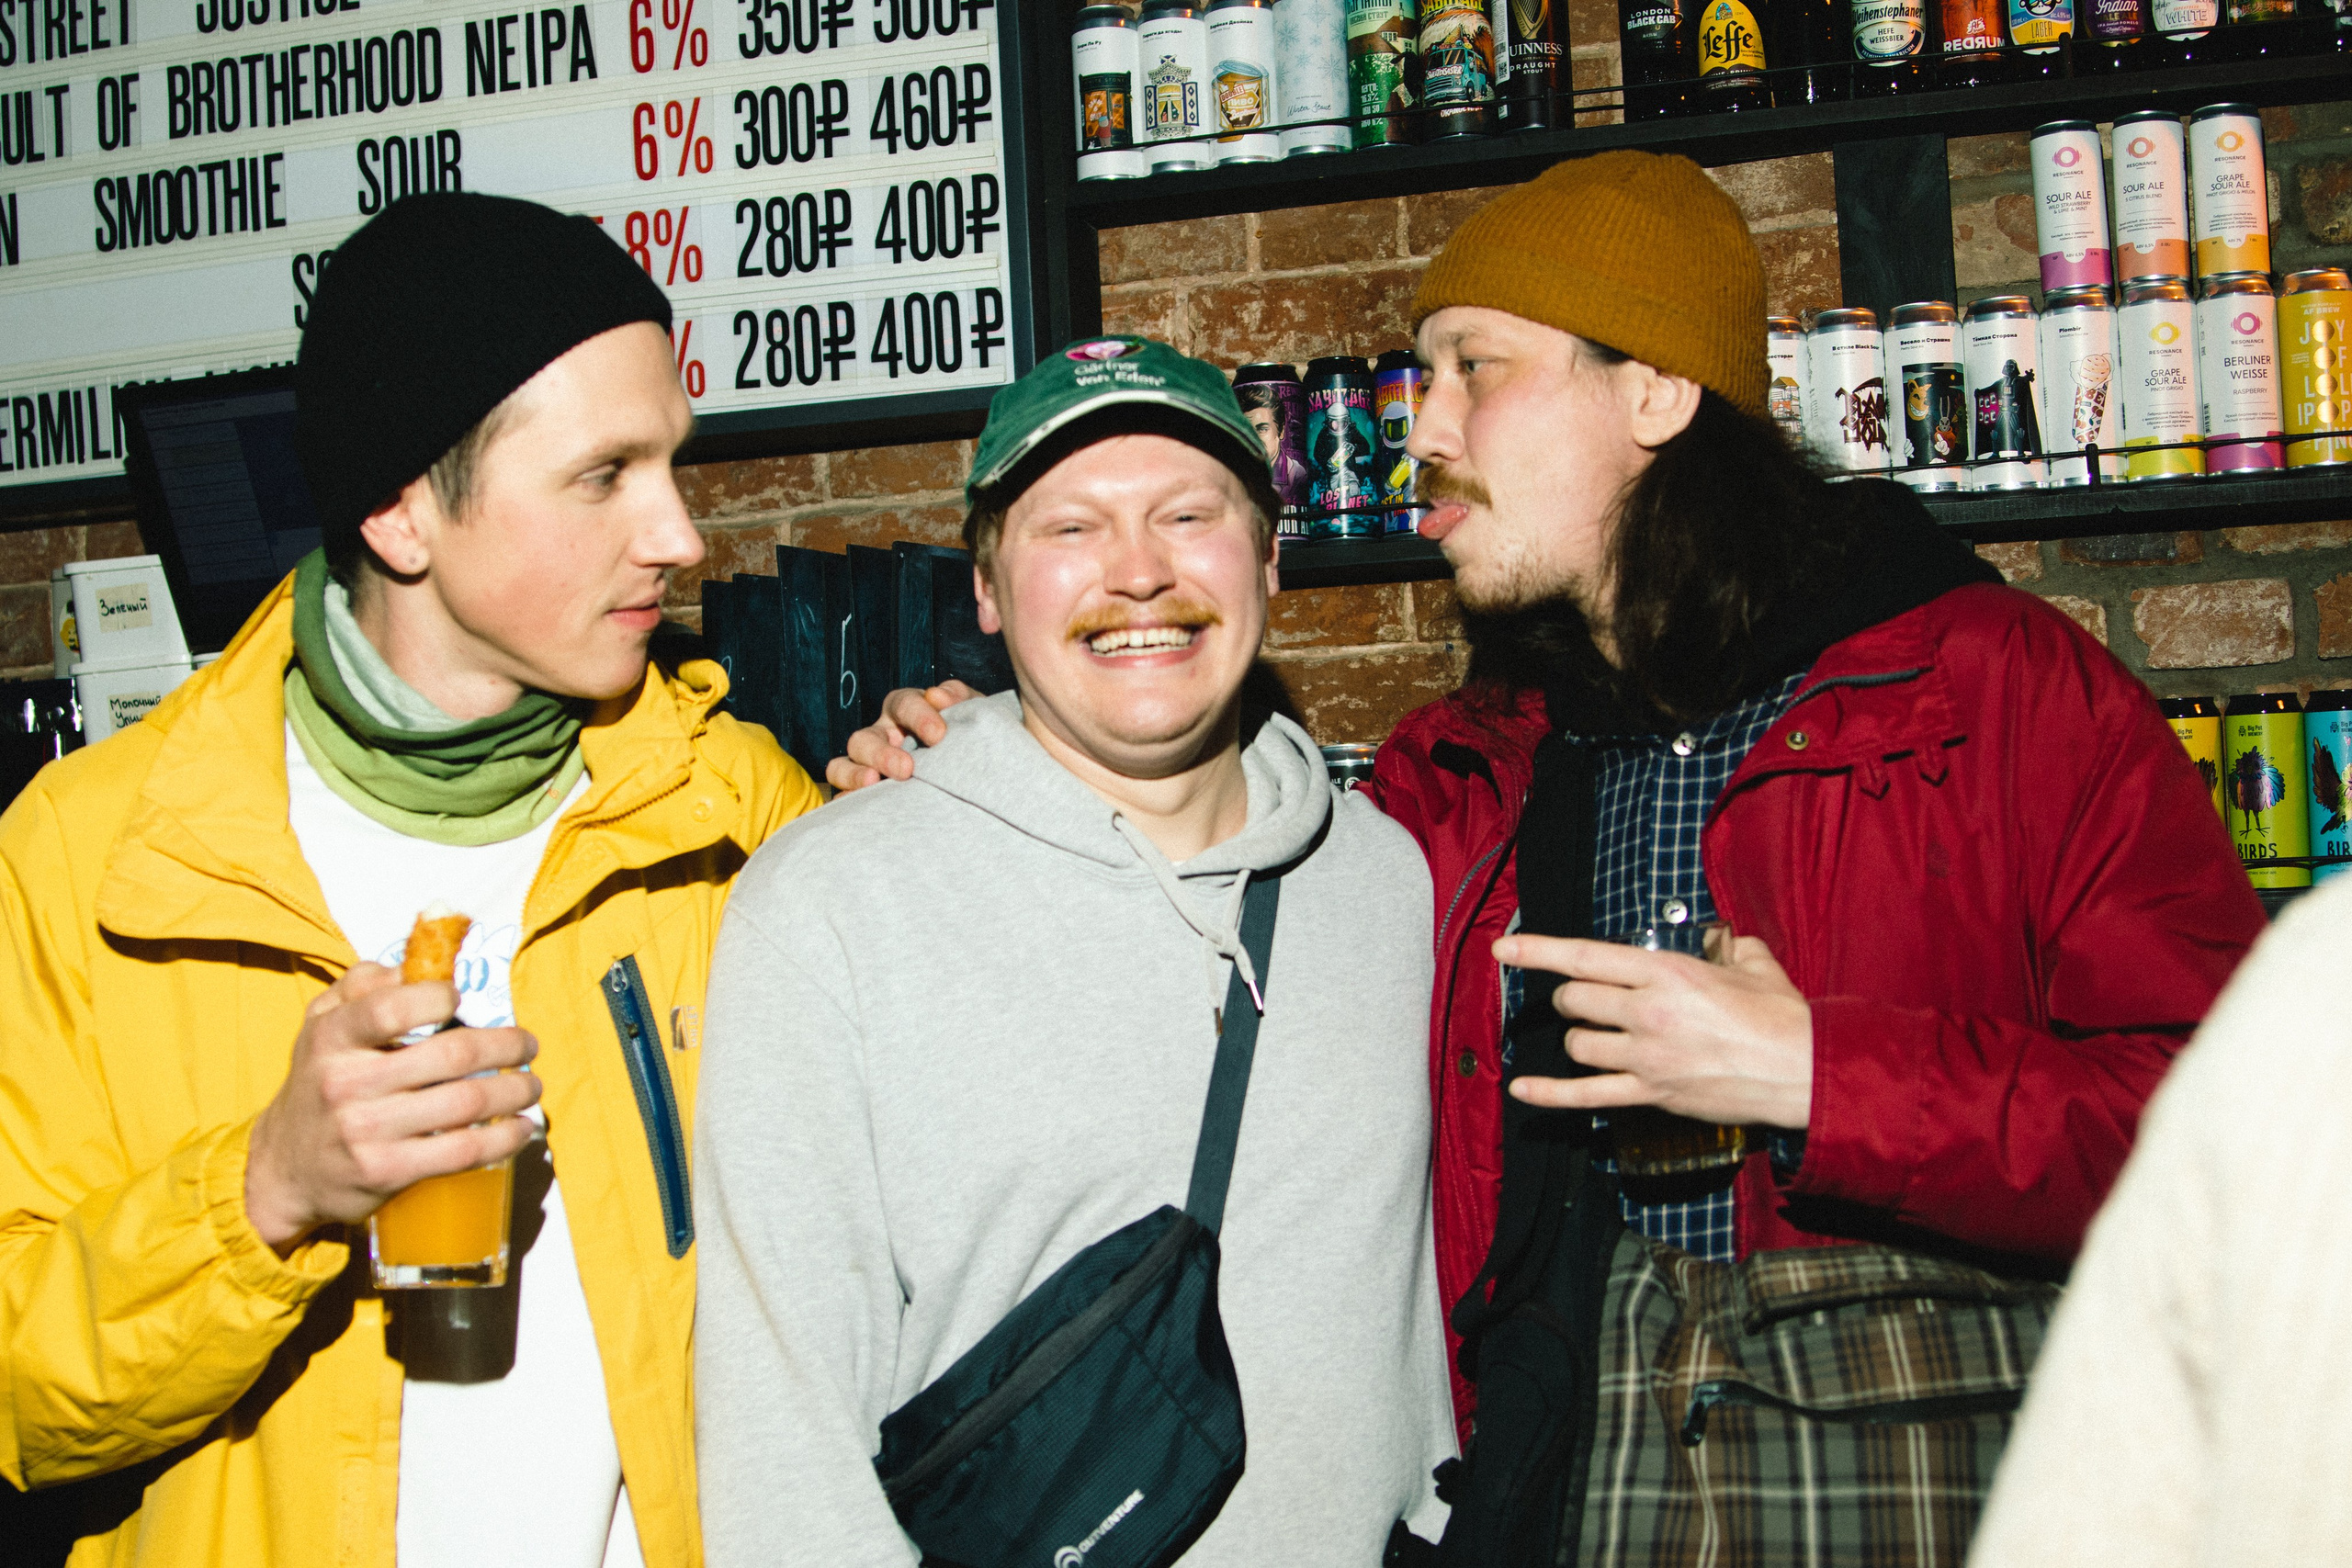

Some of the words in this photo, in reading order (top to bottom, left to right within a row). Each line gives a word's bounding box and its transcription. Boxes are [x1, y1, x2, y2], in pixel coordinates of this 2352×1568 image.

[1631, 8, 1671, 19] LONDON
[2165, 9, 2207, 25] WHITE
[1627, 16, 1656, 30] BLACK
[1657, 15, 1676, 25] CAB
[0, 0, 129, 67] STREET
[2031, 21, 2052, 39] LAGER
[1702, 20, 1755, 63] Leffe
[1870, 35, 1905, 45] WEISSBIER
[1510, 42, 1562, 57] UINNESS
[1510, 62, 1555, 71] DRAUGHT
[0, 85, 70, 166] ULT
[96, 73, 140, 151] OF
[166, 27, 443, 140] BROTHERHOOD
[465, 6, 597, 97] NEIPA
[629, 0, 708, 73] 6%
[1227, 97, 1254, 106] ПИВО
[94, 152, 287, 253] SMOOTHIE
[357, 130, 462, 215] SOUR
[633, 97, 713, 180] 6%
[735, 79, 850, 169] 300₽
[870, 63, 992, 154] 460₽
[2216, 174, 2245, 183] GRAPE
[2123, 184, 2144, 194] SOUR
[2148, 181, 2165, 190] ALE
[2211, 181, 2233, 191] SOUR
[2046, 192, 2072, 204] SOUR
[2075, 191, 2092, 199] ALE
[736, 188, 853, 278] 280₽
[875, 174, 1001, 264] 400₽
[733, 301, 855, 390] 280₽
[870, 288, 1005, 379] 400₽
[1973, 334, 1991, 343] Тёмная
[2224, 355, 2271, 367] BERLINER
[2151, 368, 2180, 378] GRAPE
[2231, 369, 2268, 379] WEISSE
[2145, 377, 2169, 387] SOUR
[1308, 388, 1371, 413] SABOTAGE
[1320, 485, 1350, 505] LOST
[1395, 493, 1404, 504] IN
[99, 598, 148, 616] Зеленый
[2238, 843, 2278, 859] BIRDS
